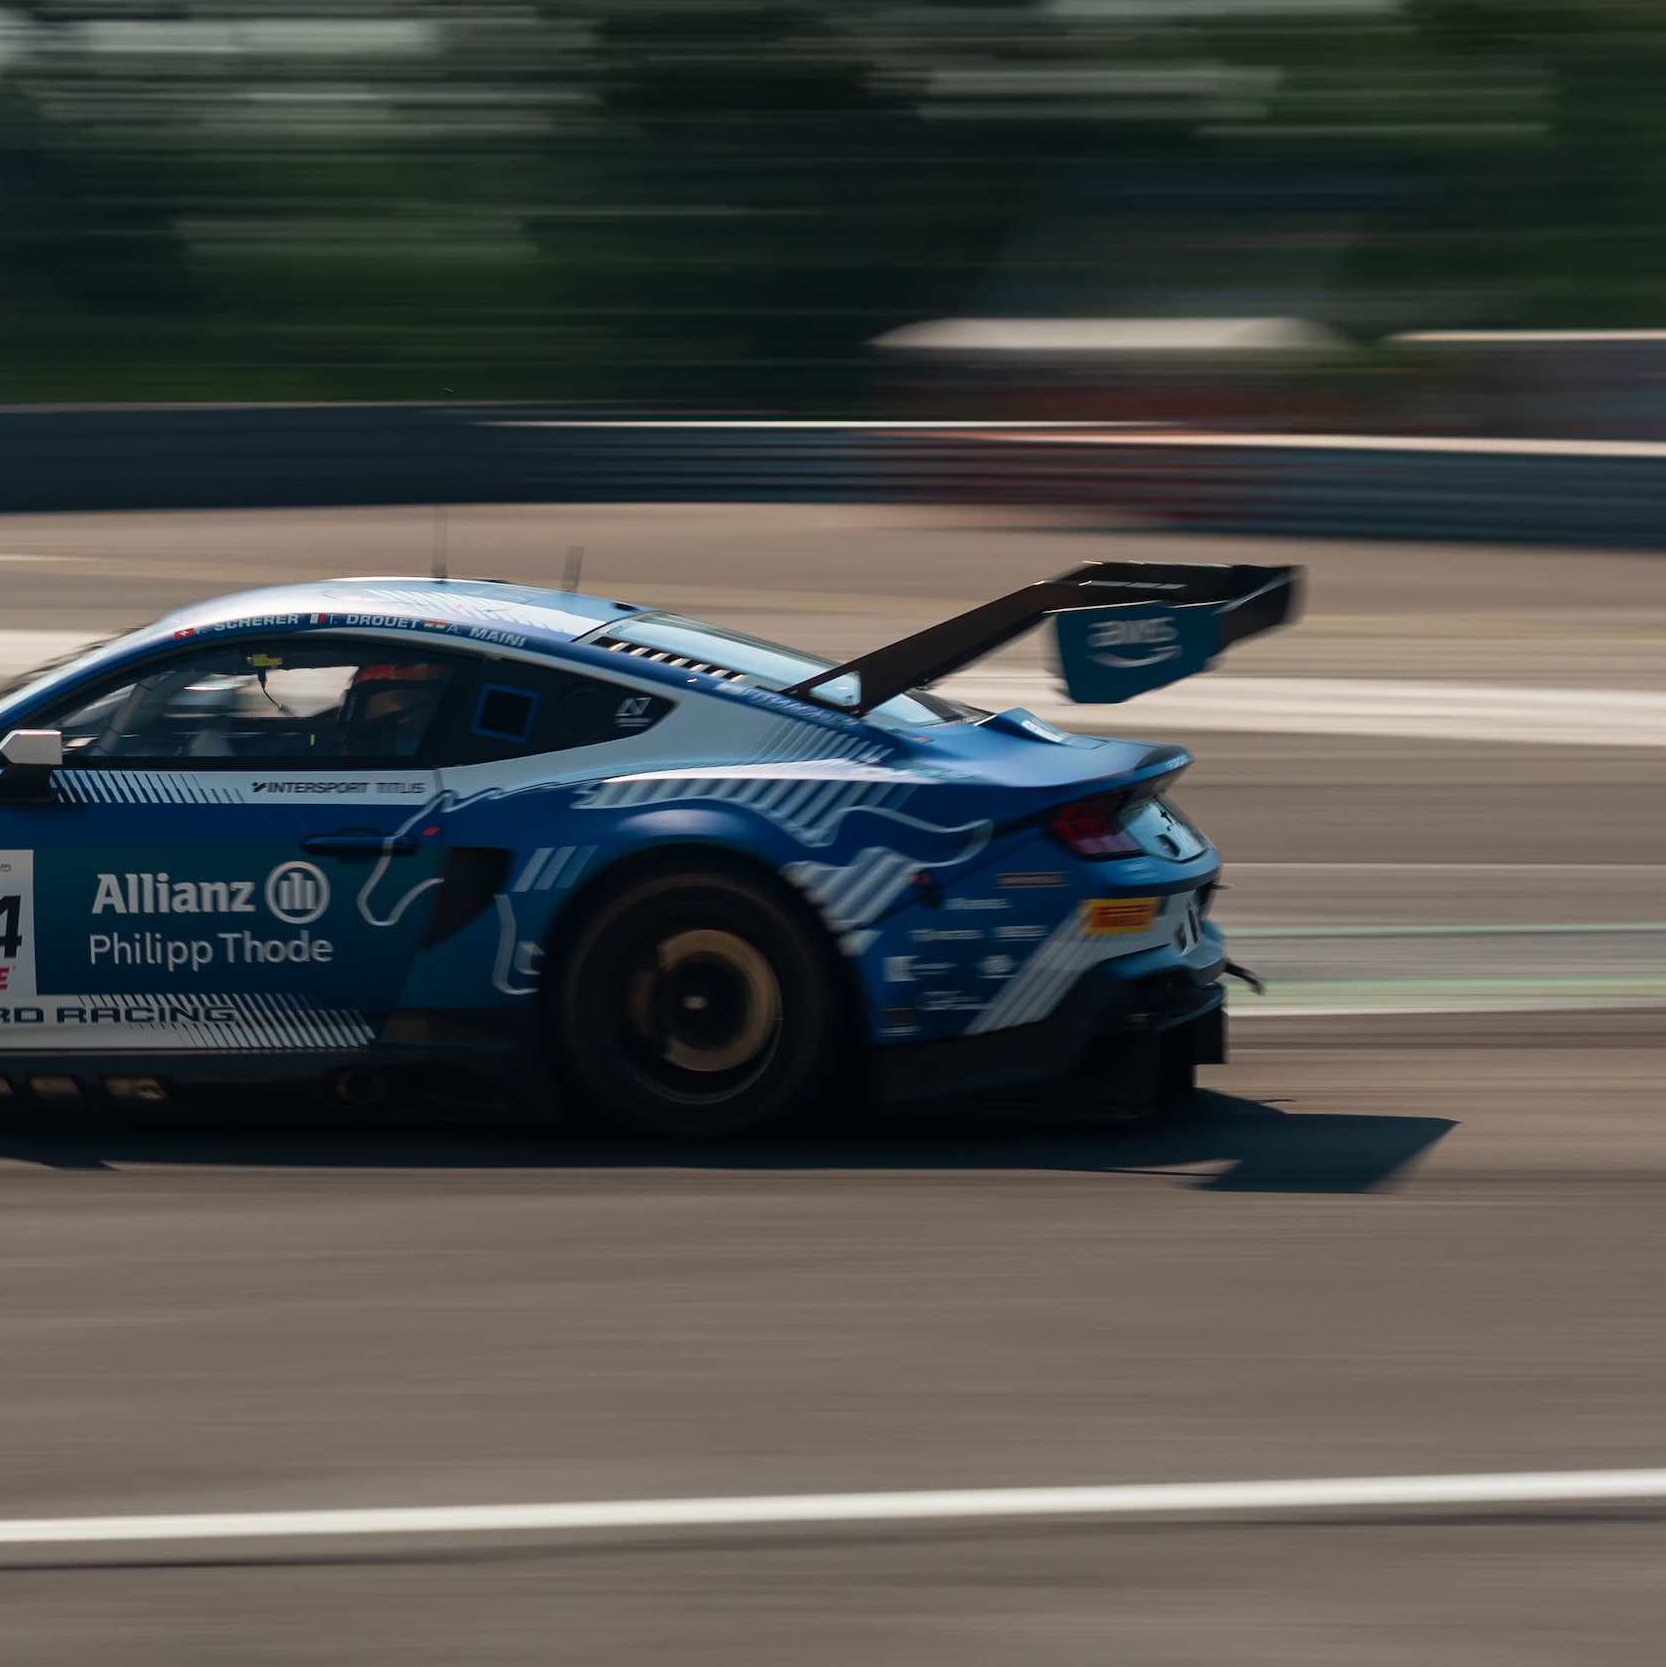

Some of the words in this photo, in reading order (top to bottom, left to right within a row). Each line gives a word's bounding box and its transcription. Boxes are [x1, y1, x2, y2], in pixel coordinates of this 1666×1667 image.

[214, 613, 299, 631] SCHERER
[346, 614, 420, 629] DROUET
[469, 627, 526, 648] MAINI
[267, 782, 371, 793] INTERSPORT
[91, 873, 256, 914] Allianz
[90, 932, 213, 971] Philipp
[219, 931, 333, 963] Thode
[57, 1006, 237, 1024] RACING
